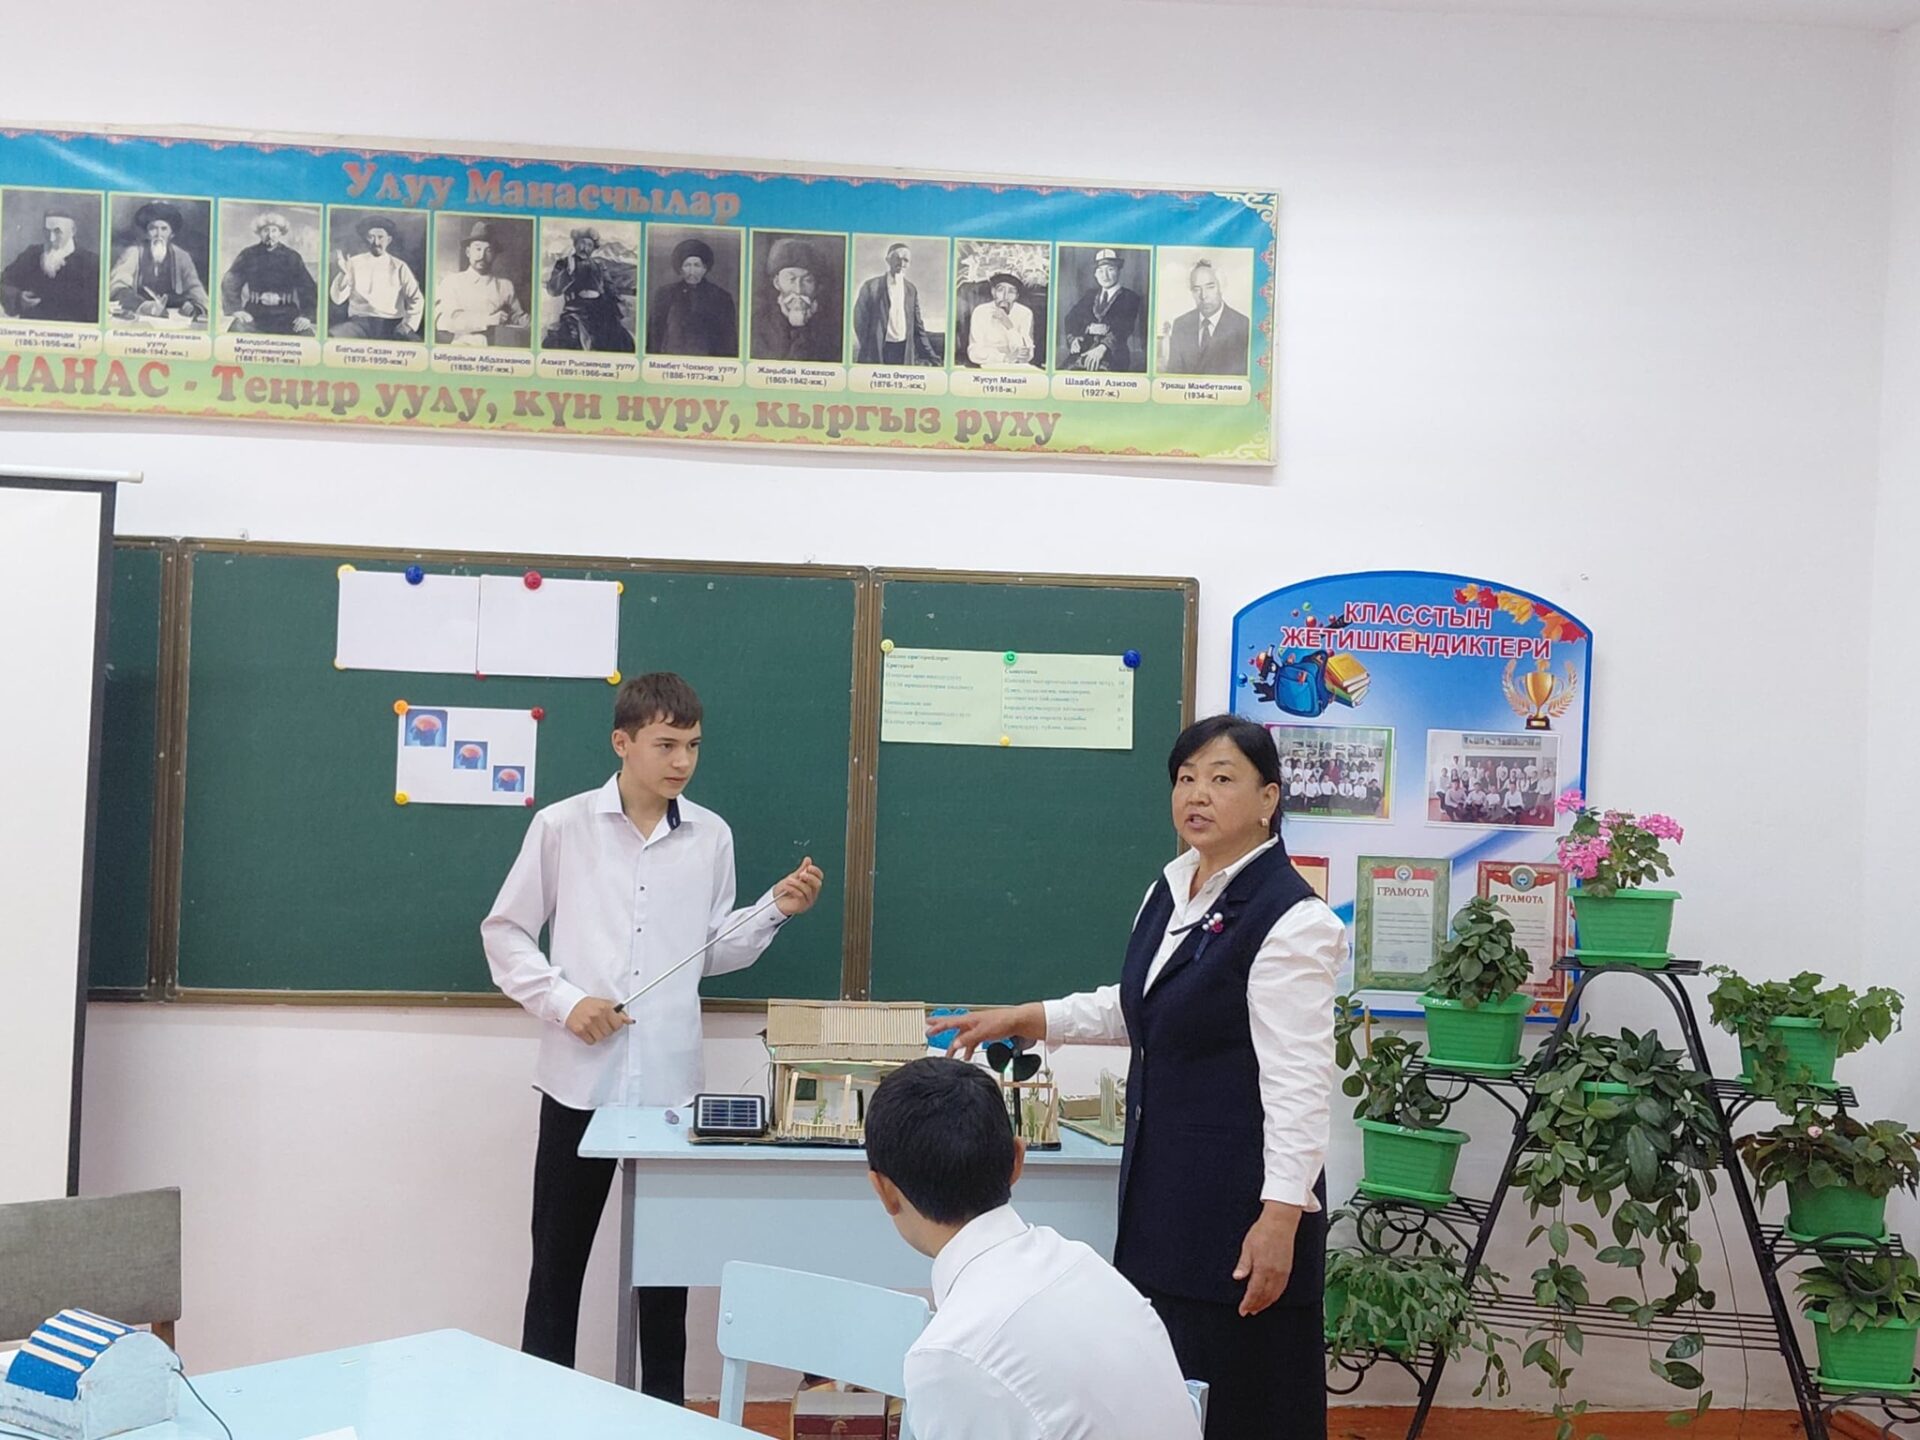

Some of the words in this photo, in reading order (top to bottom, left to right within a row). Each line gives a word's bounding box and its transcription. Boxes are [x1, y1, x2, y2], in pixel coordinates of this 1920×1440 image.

[342, 161, 455, 209] Улуу
[466, 169, 741, 225] Манасчылар
[212, 364, 361, 416] Теңир
[374, 382, 498, 424] уулу,
[512, 390, 602, 427] күн
[616, 395, 741, 434] нуру,
[755, 401, 942, 438] кыргыз
[954, 409, 1062, 446] руху
[1343, 601, 1493, 629] КЛАССТЫН
[1280, 627, 1551, 660] ЖЕТИШКЕНДИКТЕРИ
[1376, 887, 1430, 898] ГРАМОТА
[1499, 894, 1544, 905] ГРАМОТА
